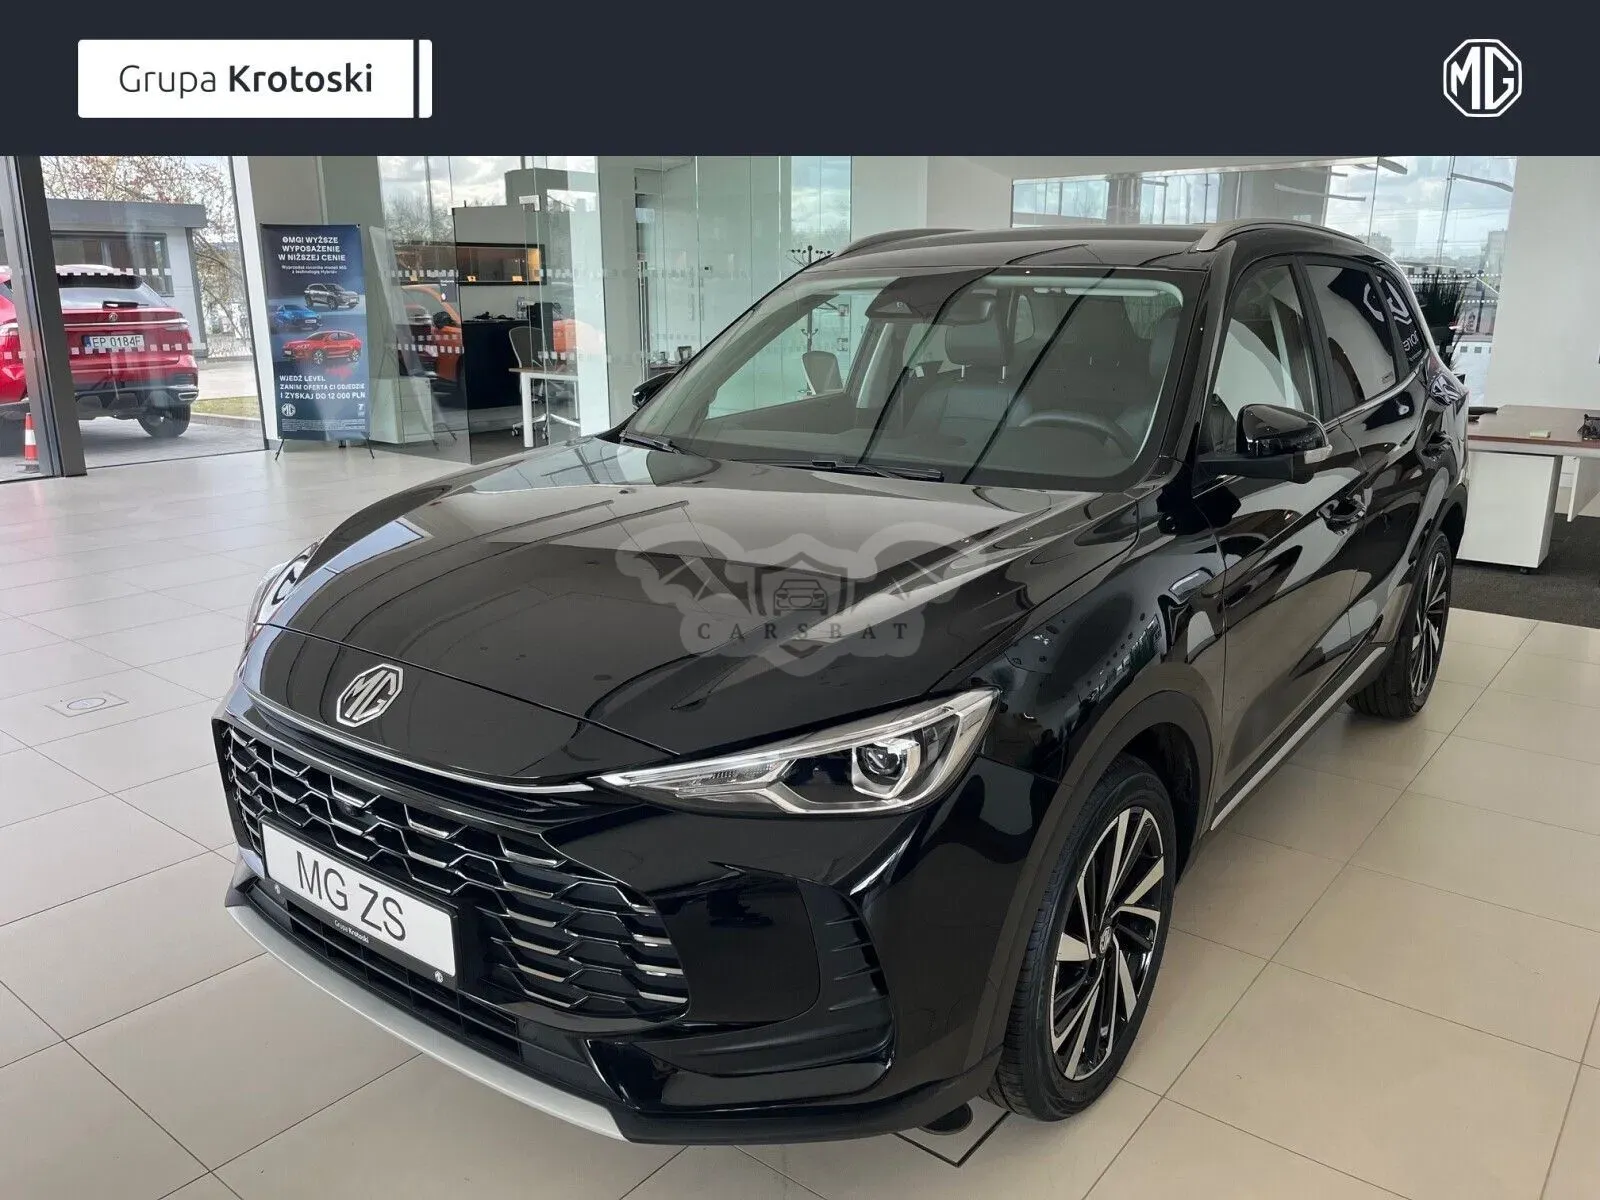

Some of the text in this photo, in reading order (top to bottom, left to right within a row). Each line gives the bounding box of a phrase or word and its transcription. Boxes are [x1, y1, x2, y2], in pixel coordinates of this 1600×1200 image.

[305, 235, 339, 244] WYŻSZE
[282, 244, 341, 253] WYPOSAŻENIE
[287, 253, 320, 261] NIŻSZEJ
[92, 337, 106, 348] EP
[284, 392, 314, 400] ZYSKAJ
[352, 391, 366, 399] PLN
[343, 669, 397, 722] MG
[296, 850, 406, 942] MG ZS
